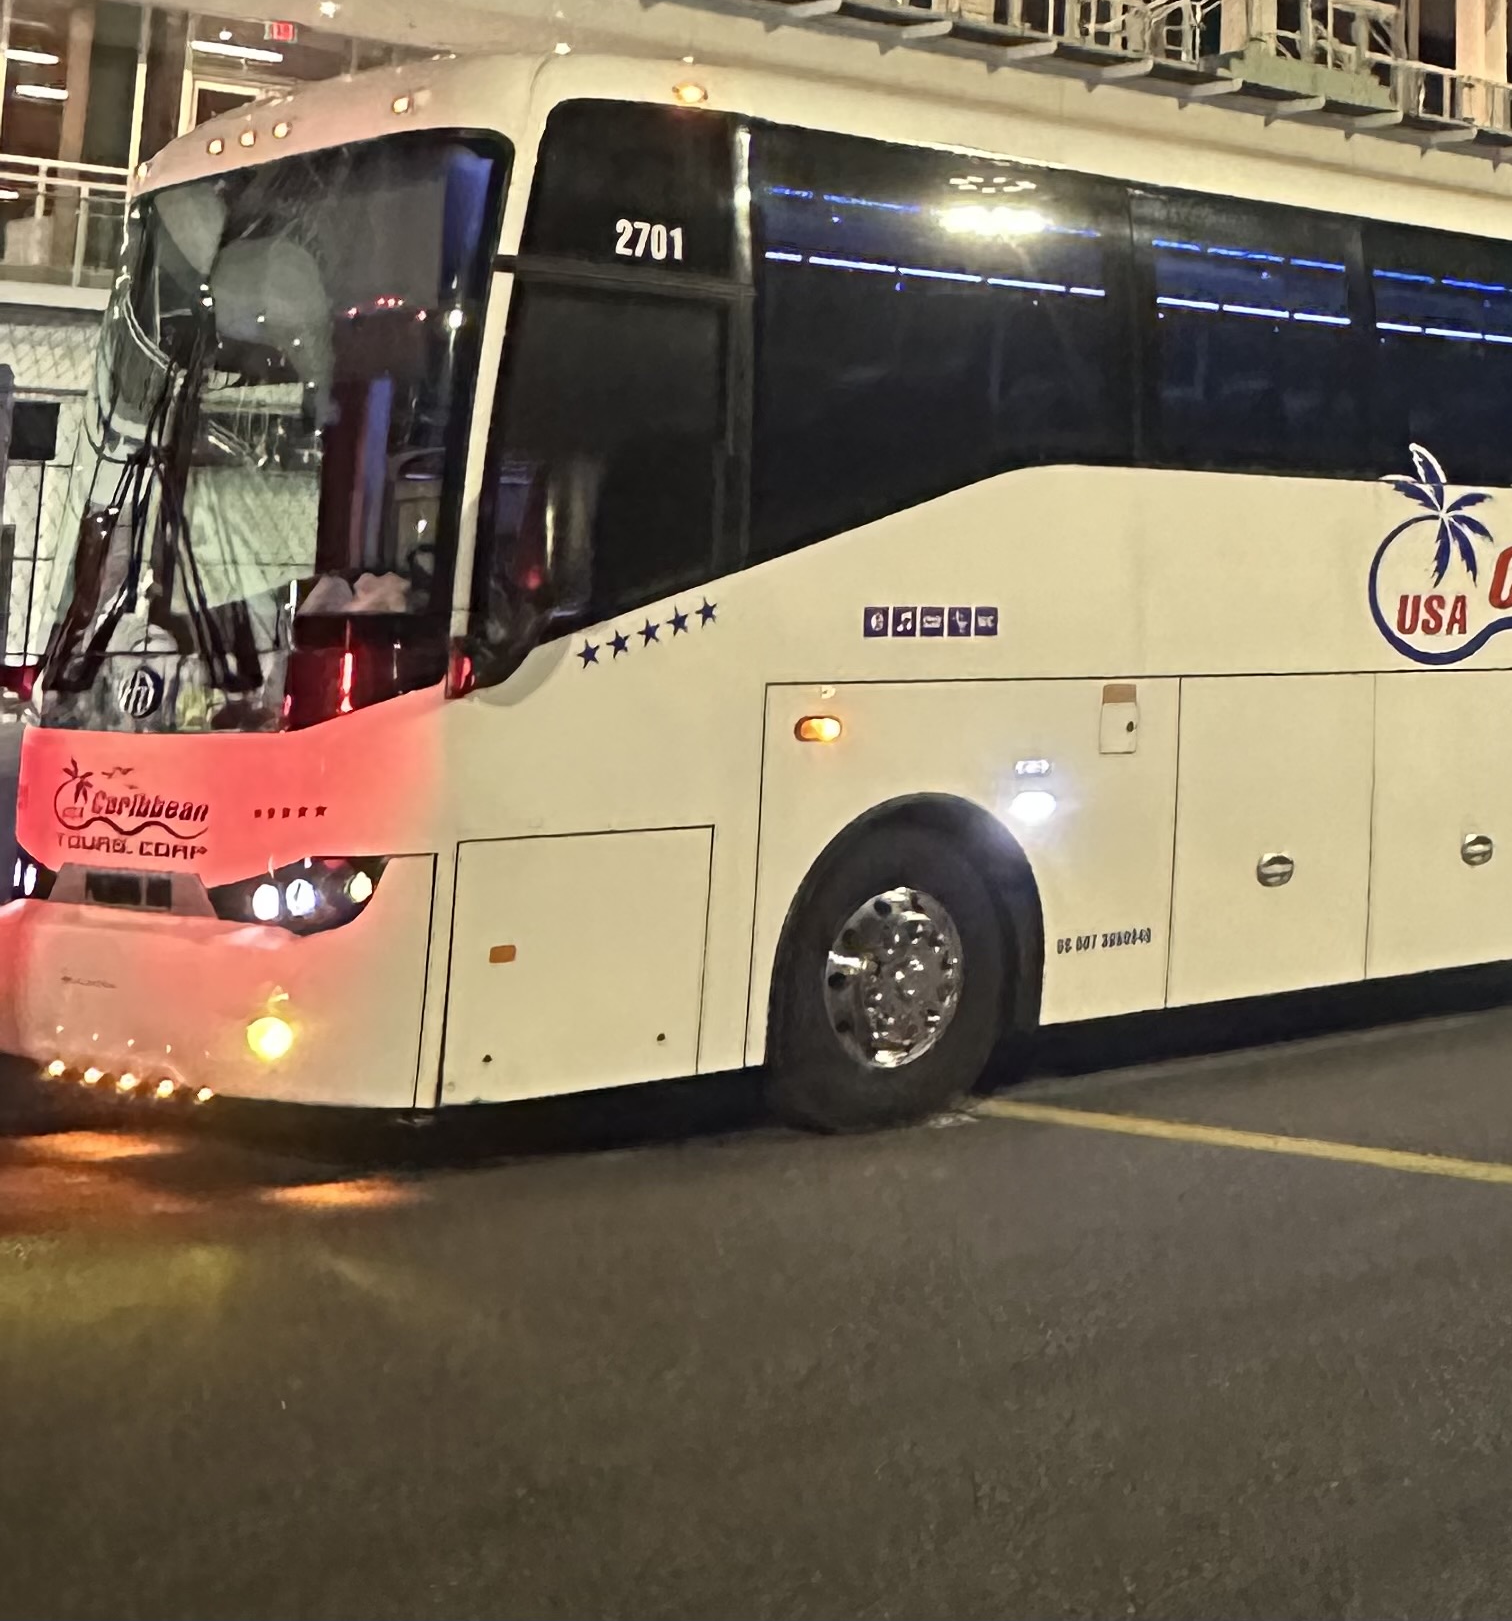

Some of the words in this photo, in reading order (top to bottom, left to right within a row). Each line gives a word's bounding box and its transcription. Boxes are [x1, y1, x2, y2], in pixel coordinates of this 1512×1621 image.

[615, 218, 683, 261] 2701
[1396, 594, 1468, 636] USA
[91, 790, 209, 822] Caribbean
